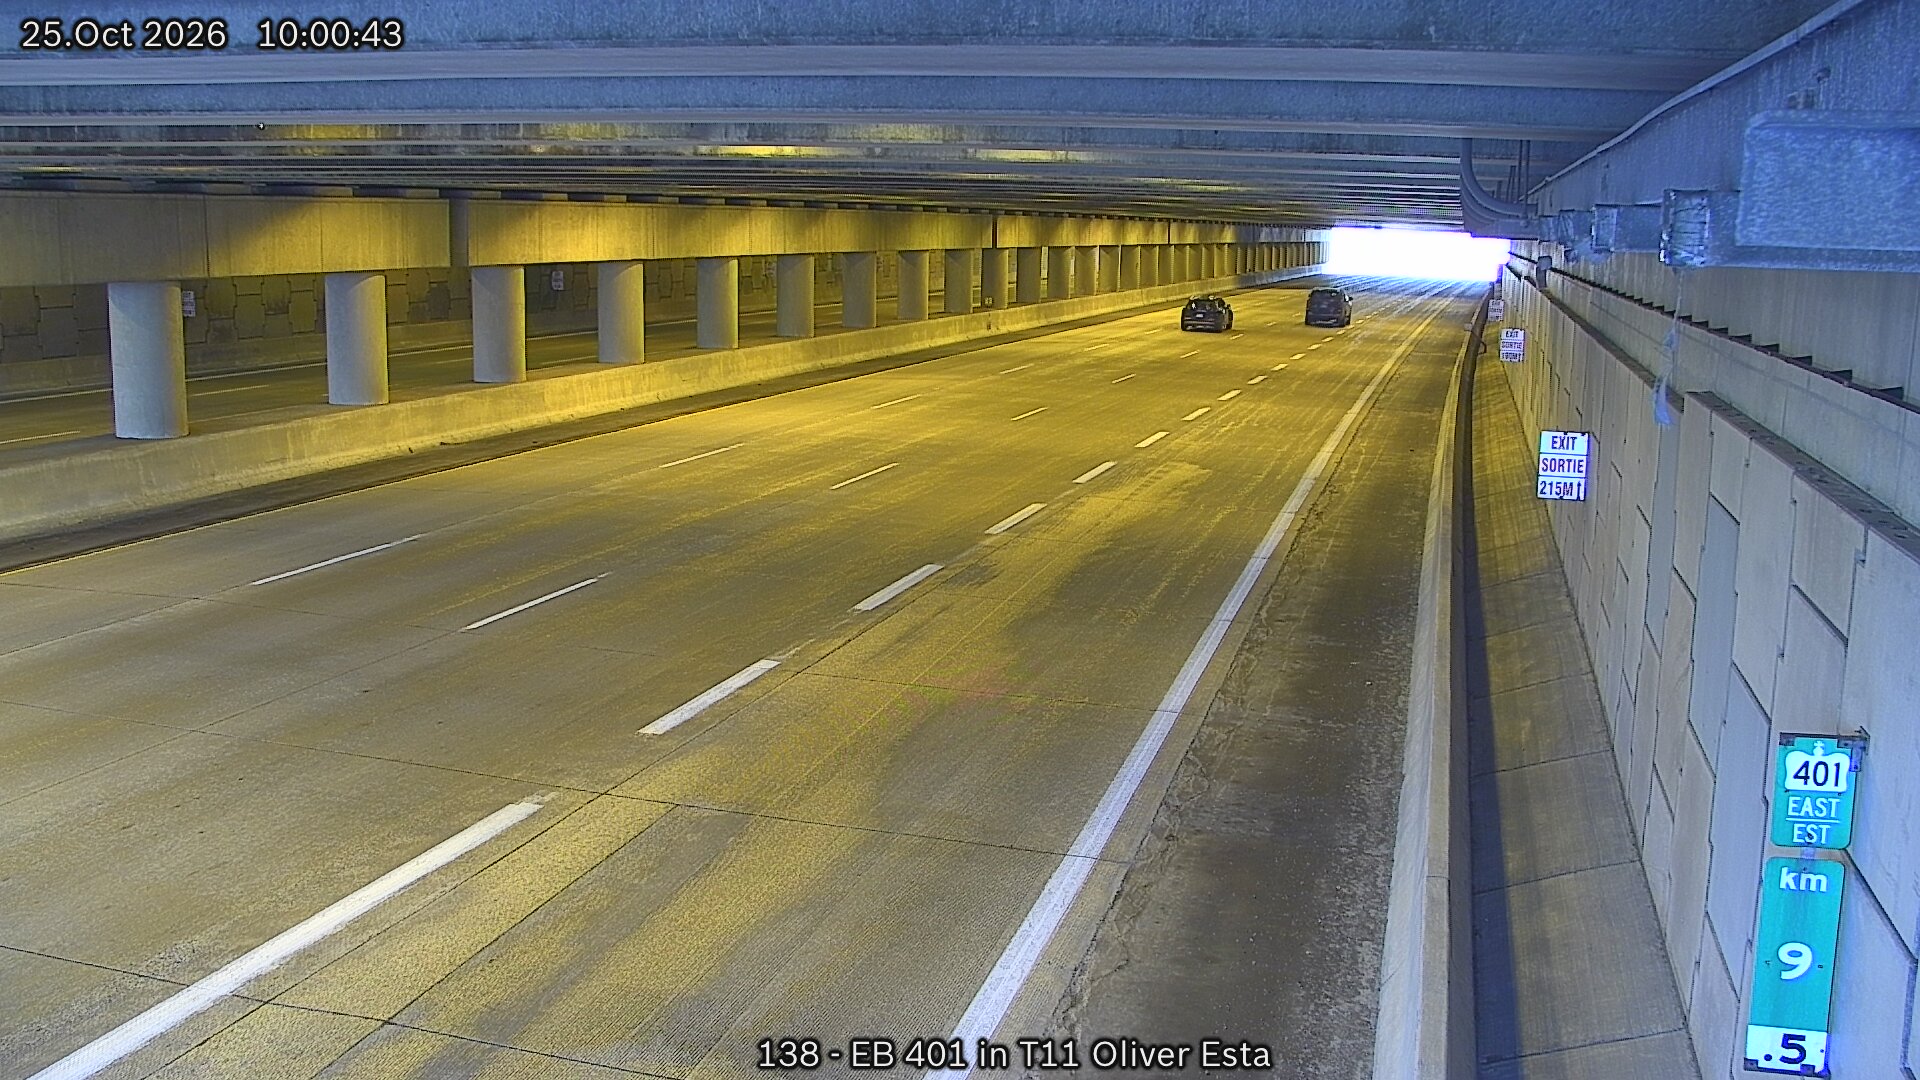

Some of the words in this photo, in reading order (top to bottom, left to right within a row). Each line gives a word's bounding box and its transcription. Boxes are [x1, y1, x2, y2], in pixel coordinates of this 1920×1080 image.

[1551, 435, 1578, 451] EXIT
[1541, 457, 1584, 474] SORTIE
[1539, 480, 1574, 497] 215M
[1793, 760, 1841, 787] 401
[1787, 796, 1841, 818] EAST
[1793, 823, 1831, 844] EST
[1779, 866, 1828, 893] km
[1777, 942, 1814, 980] 9
[1763, 1033, 1807, 1065] .5
